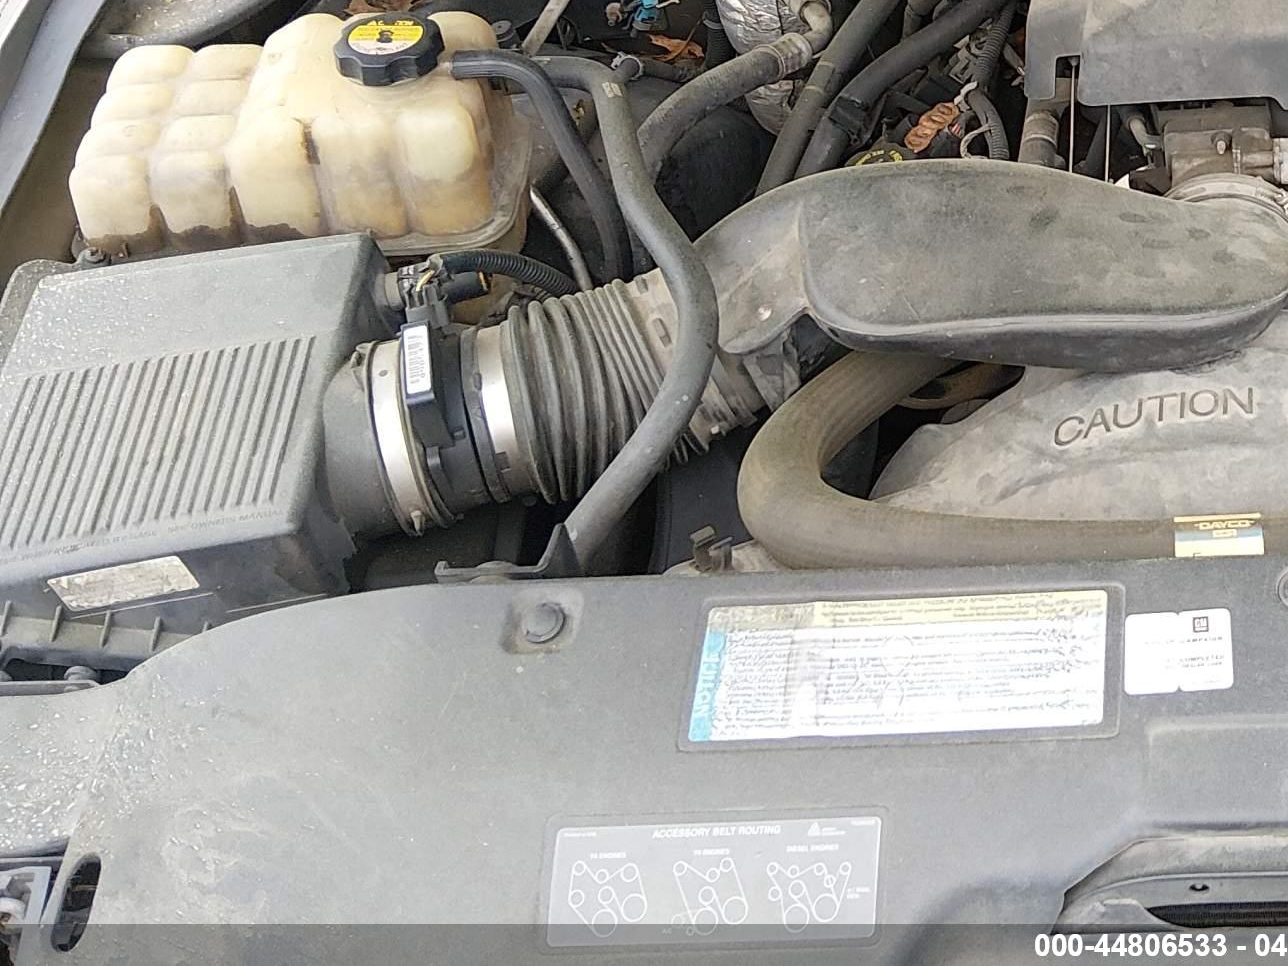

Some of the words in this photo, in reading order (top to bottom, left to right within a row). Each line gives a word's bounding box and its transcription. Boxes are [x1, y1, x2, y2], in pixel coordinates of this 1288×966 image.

[1053, 386, 1254, 447] CAUTION
[1198, 519, 1252, 531] DAYCO
[652, 826, 711, 839] ACCESSORY
[712, 825, 737, 837] BELT
[738, 824, 782, 836] ROUTING
